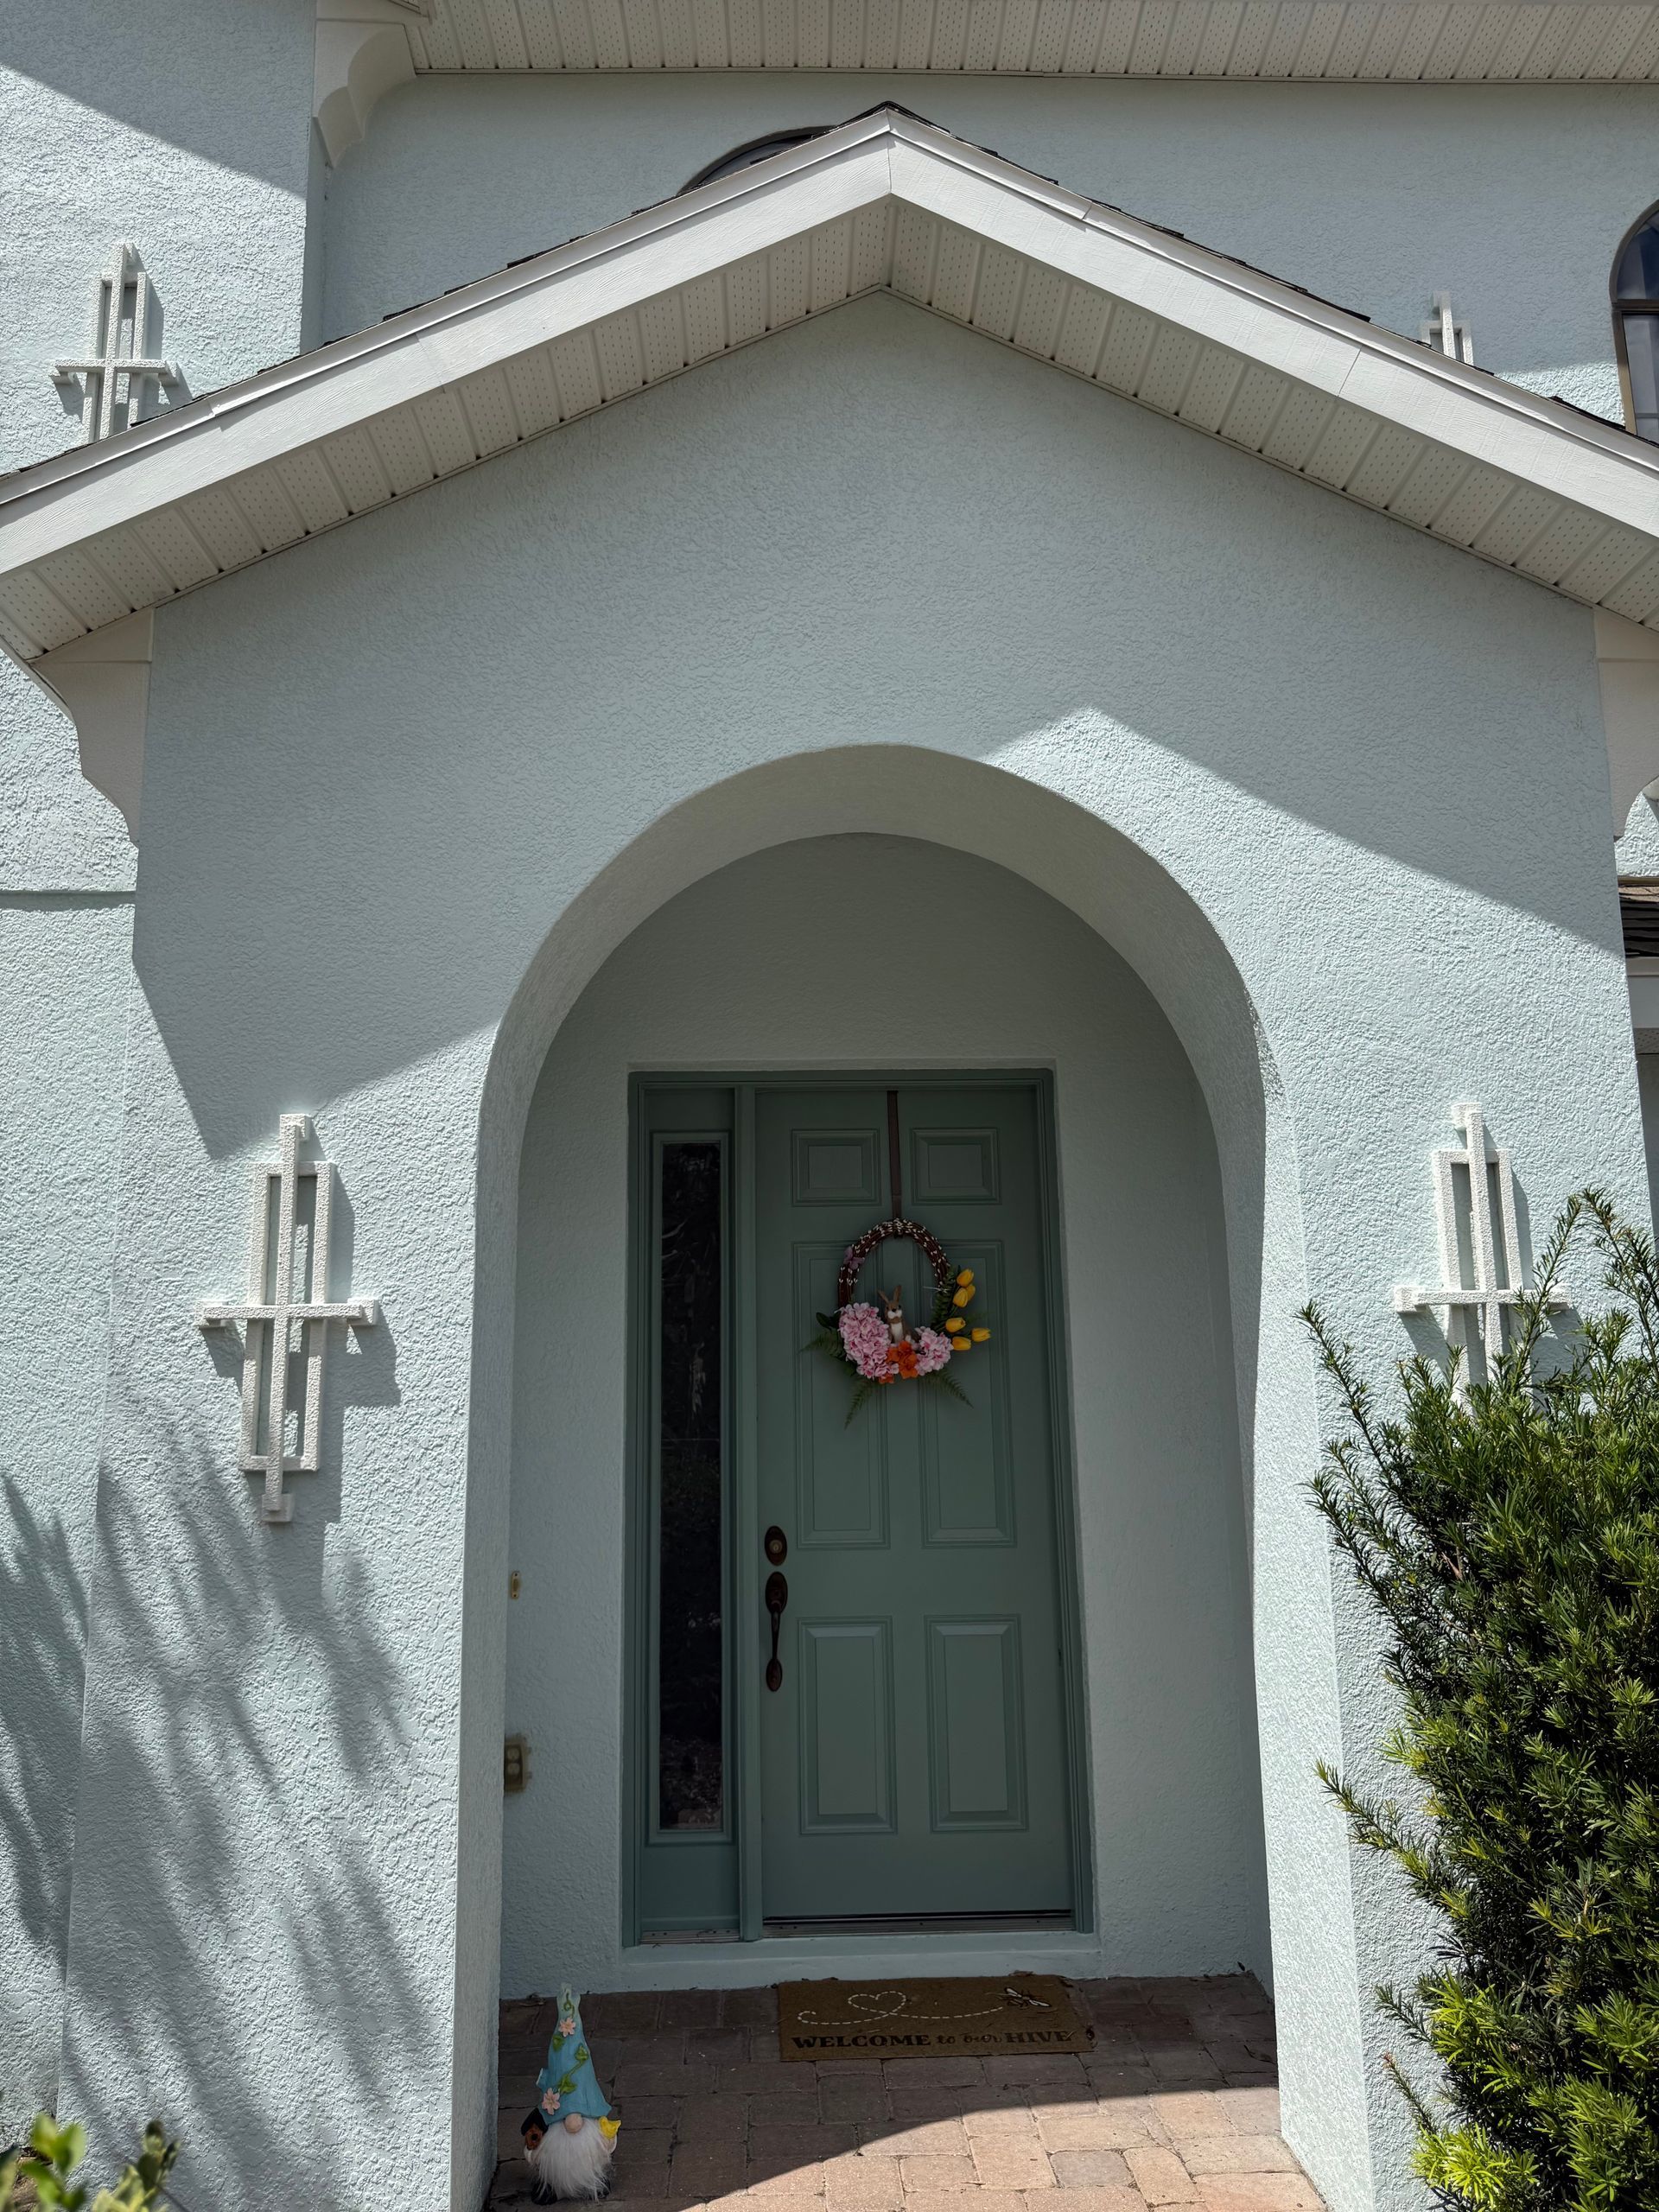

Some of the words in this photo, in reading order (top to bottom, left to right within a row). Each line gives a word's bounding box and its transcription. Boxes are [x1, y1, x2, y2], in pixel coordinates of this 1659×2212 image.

[792, 2034, 931, 2049] WELCOME
[937, 2034, 956, 2044] to
[963, 2034, 1002, 2044] our
[1005, 2031, 1072, 2044] HIVE
